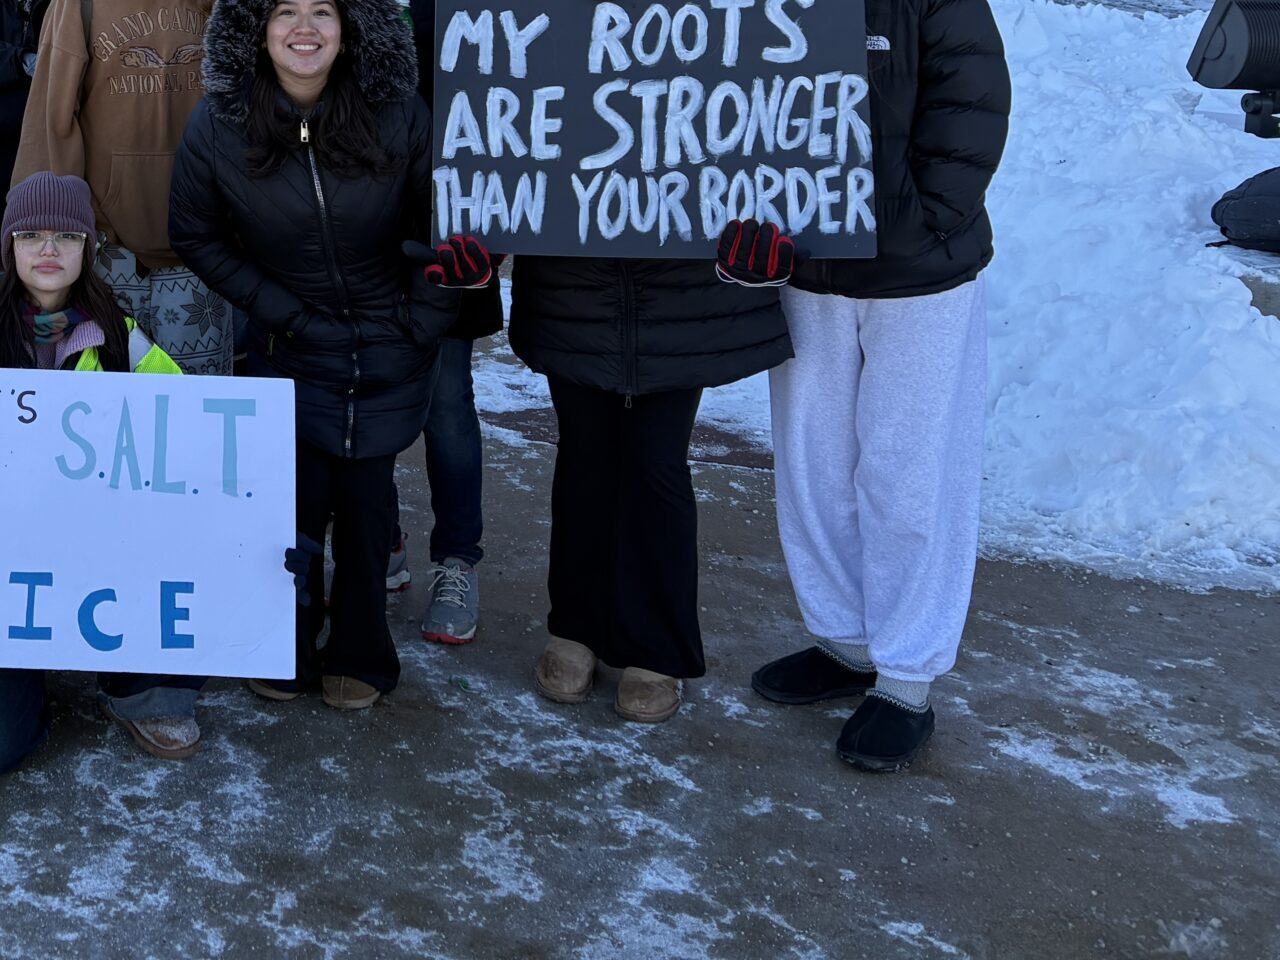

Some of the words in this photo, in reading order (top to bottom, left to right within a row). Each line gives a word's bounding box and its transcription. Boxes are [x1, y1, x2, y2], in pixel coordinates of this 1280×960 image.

[93, 10, 154, 62] GRAND
[439, 8, 550, 79] MY
[107, 72, 182, 95] NATIONAL
[441, 85, 566, 160] ARE
[579, 71, 873, 172] STRONGER
[433, 165, 548, 240] THAN
[571, 168, 693, 246] YOUR
[699, 163, 876, 240] BORDER
[8, 571, 195, 652] ICE
